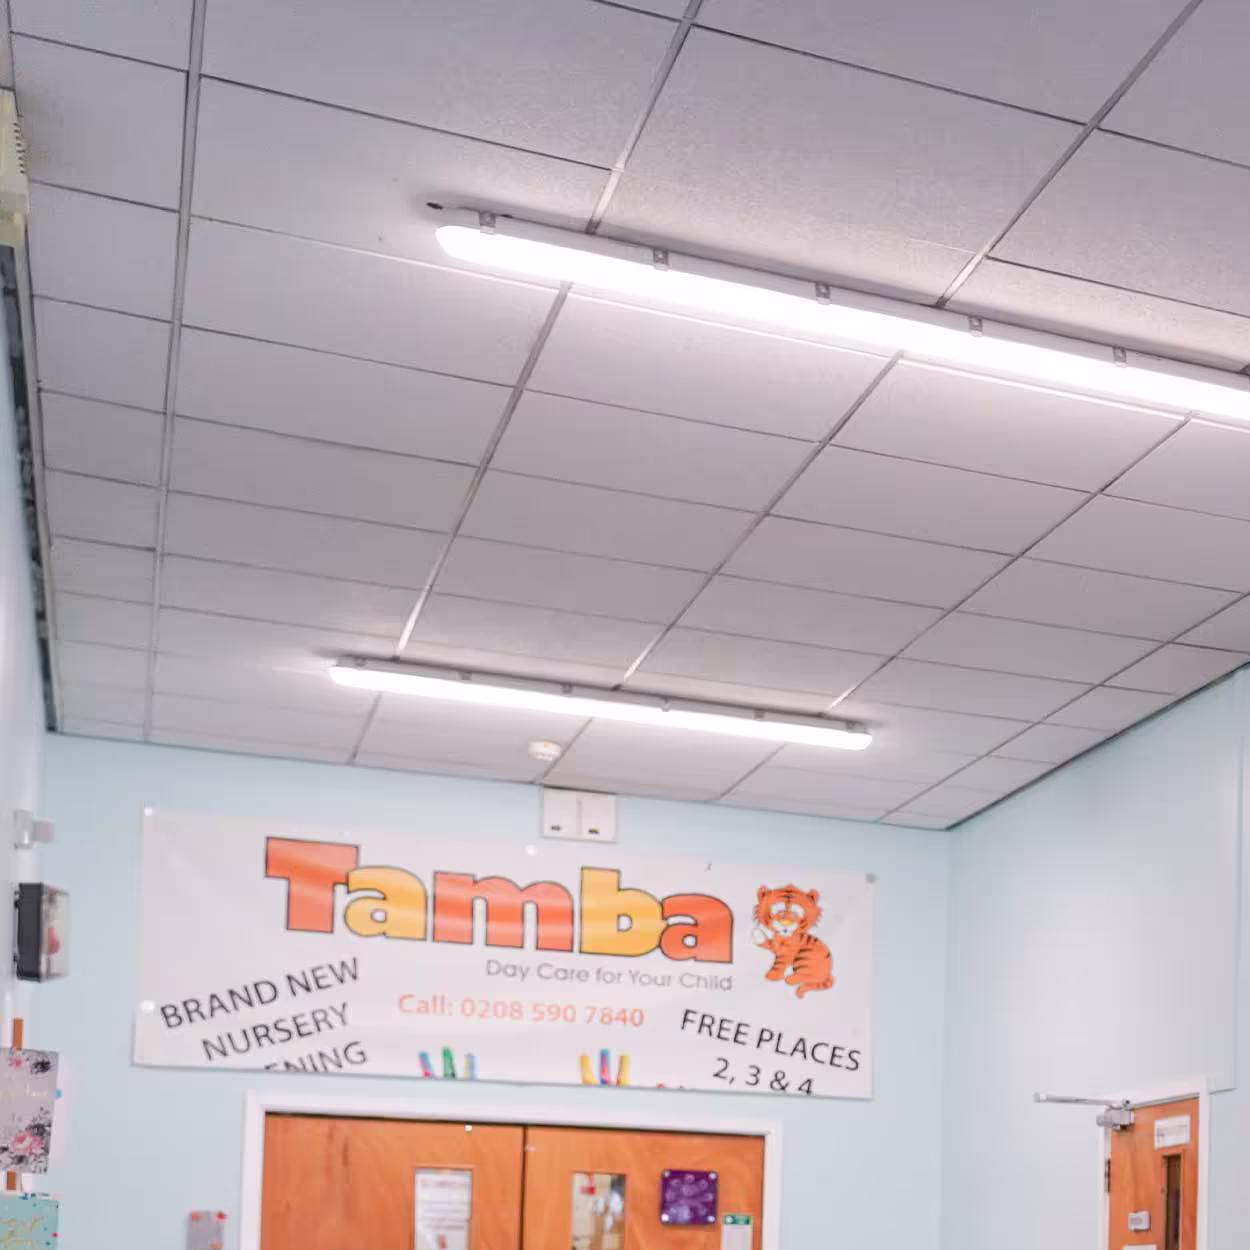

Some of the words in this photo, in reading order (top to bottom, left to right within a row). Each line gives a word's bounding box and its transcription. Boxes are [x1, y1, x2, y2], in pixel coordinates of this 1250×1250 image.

[264, 836, 734, 964] Tamba
[161, 980, 278, 1029] BRAND
[286, 957, 360, 997] NEW
[486, 959, 531, 982] Day
[537, 963, 588, 983] Care
[595, 965, 622, 984] for
[628, 969, 672, 988] Your
[679, 972, 733, 992] Child
[202, 1001, 349, 1062] NURSERY
[399, 994, 453, 1016] Call:
[460, 996, 524, 1020] 0208
[531, 1000, 576, 1023] 590
[585, 1004, 645, 1027] 7840
[681, 1009, 749, 1046] FREE
[756, 1028, 861, 1072] PLACES
[712, 1057, 736, 1085] 2,
[744, 1064, 761, 1086] 3
[770, 1070, 790, 1093] &
[797, 1077, 814, 1095] 4
